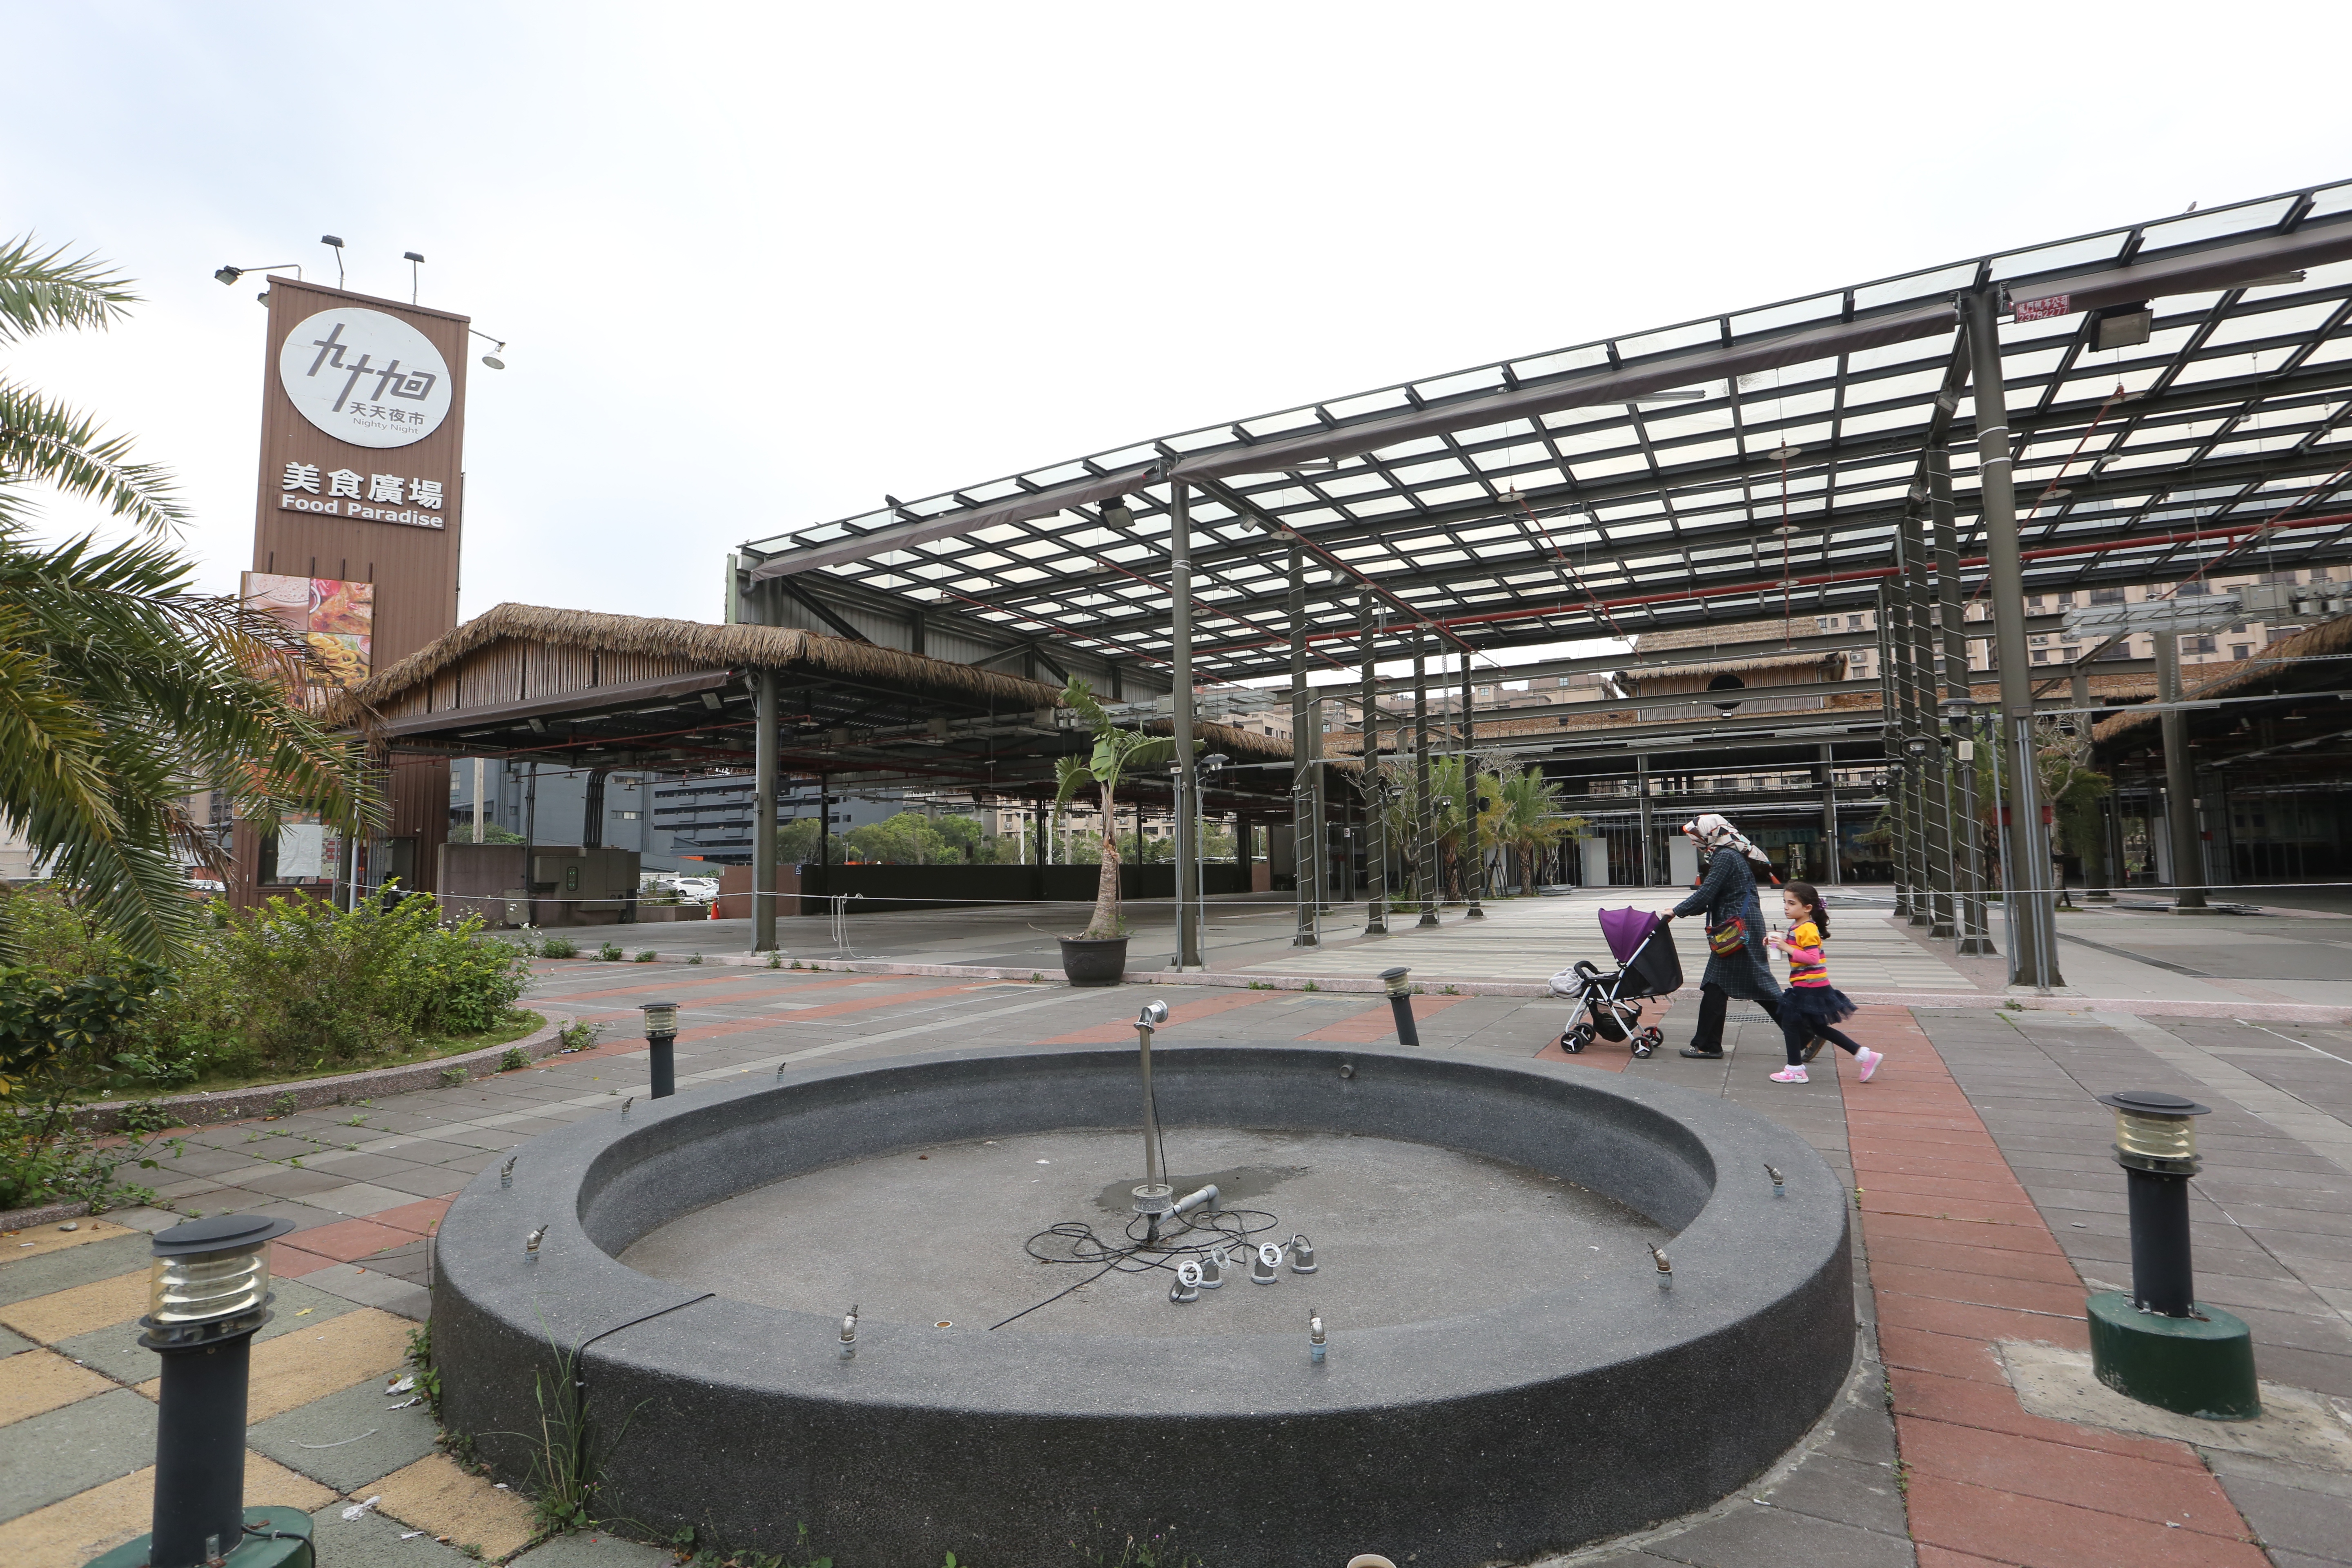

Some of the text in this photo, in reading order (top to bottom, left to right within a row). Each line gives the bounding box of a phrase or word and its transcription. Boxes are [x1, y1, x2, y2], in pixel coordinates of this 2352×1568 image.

[2018, 306, 2067, 322] 23782277
[350, 401, 425, 425] 天天夜市
[353, 418, 419, 434] Nighty Night
[282, 462, 444, 510] 美食廣場
[282, 494, 443, 528] Food Paradise
